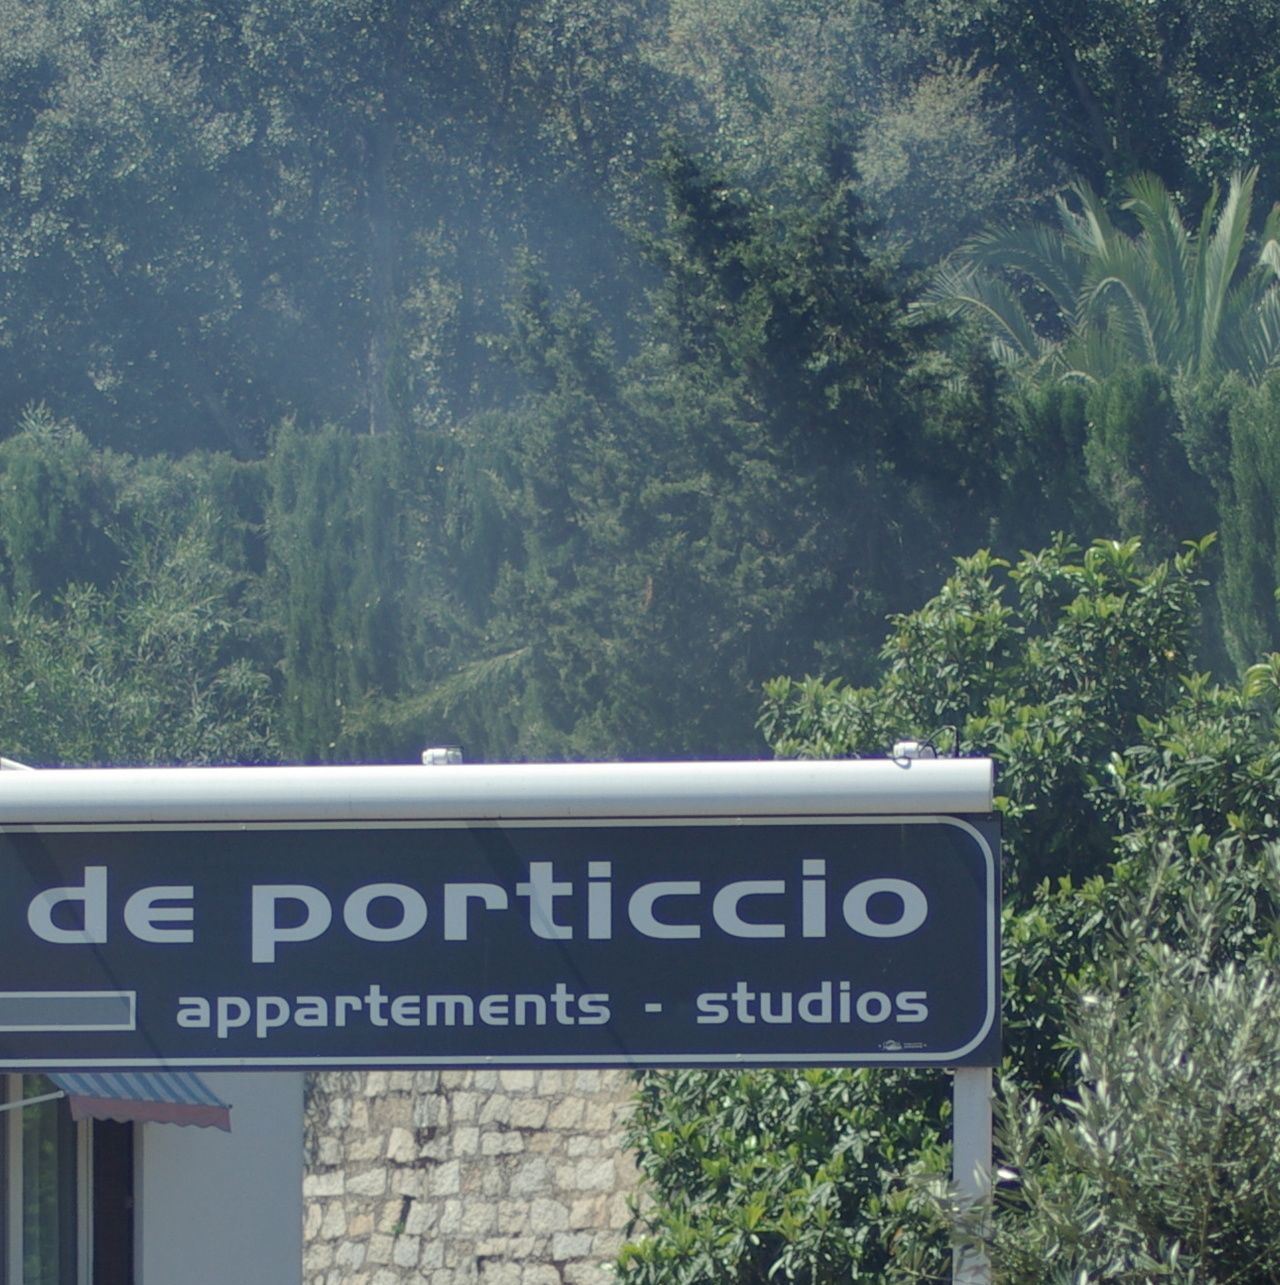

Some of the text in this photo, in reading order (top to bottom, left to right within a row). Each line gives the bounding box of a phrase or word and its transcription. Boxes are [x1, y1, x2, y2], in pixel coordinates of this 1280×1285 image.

[26, 865, 194, 944] de
[251, 859, 928, 964] porticcio
[176, 983, 611, 1039] appartements
[696, 980, 929, 1024] studios
